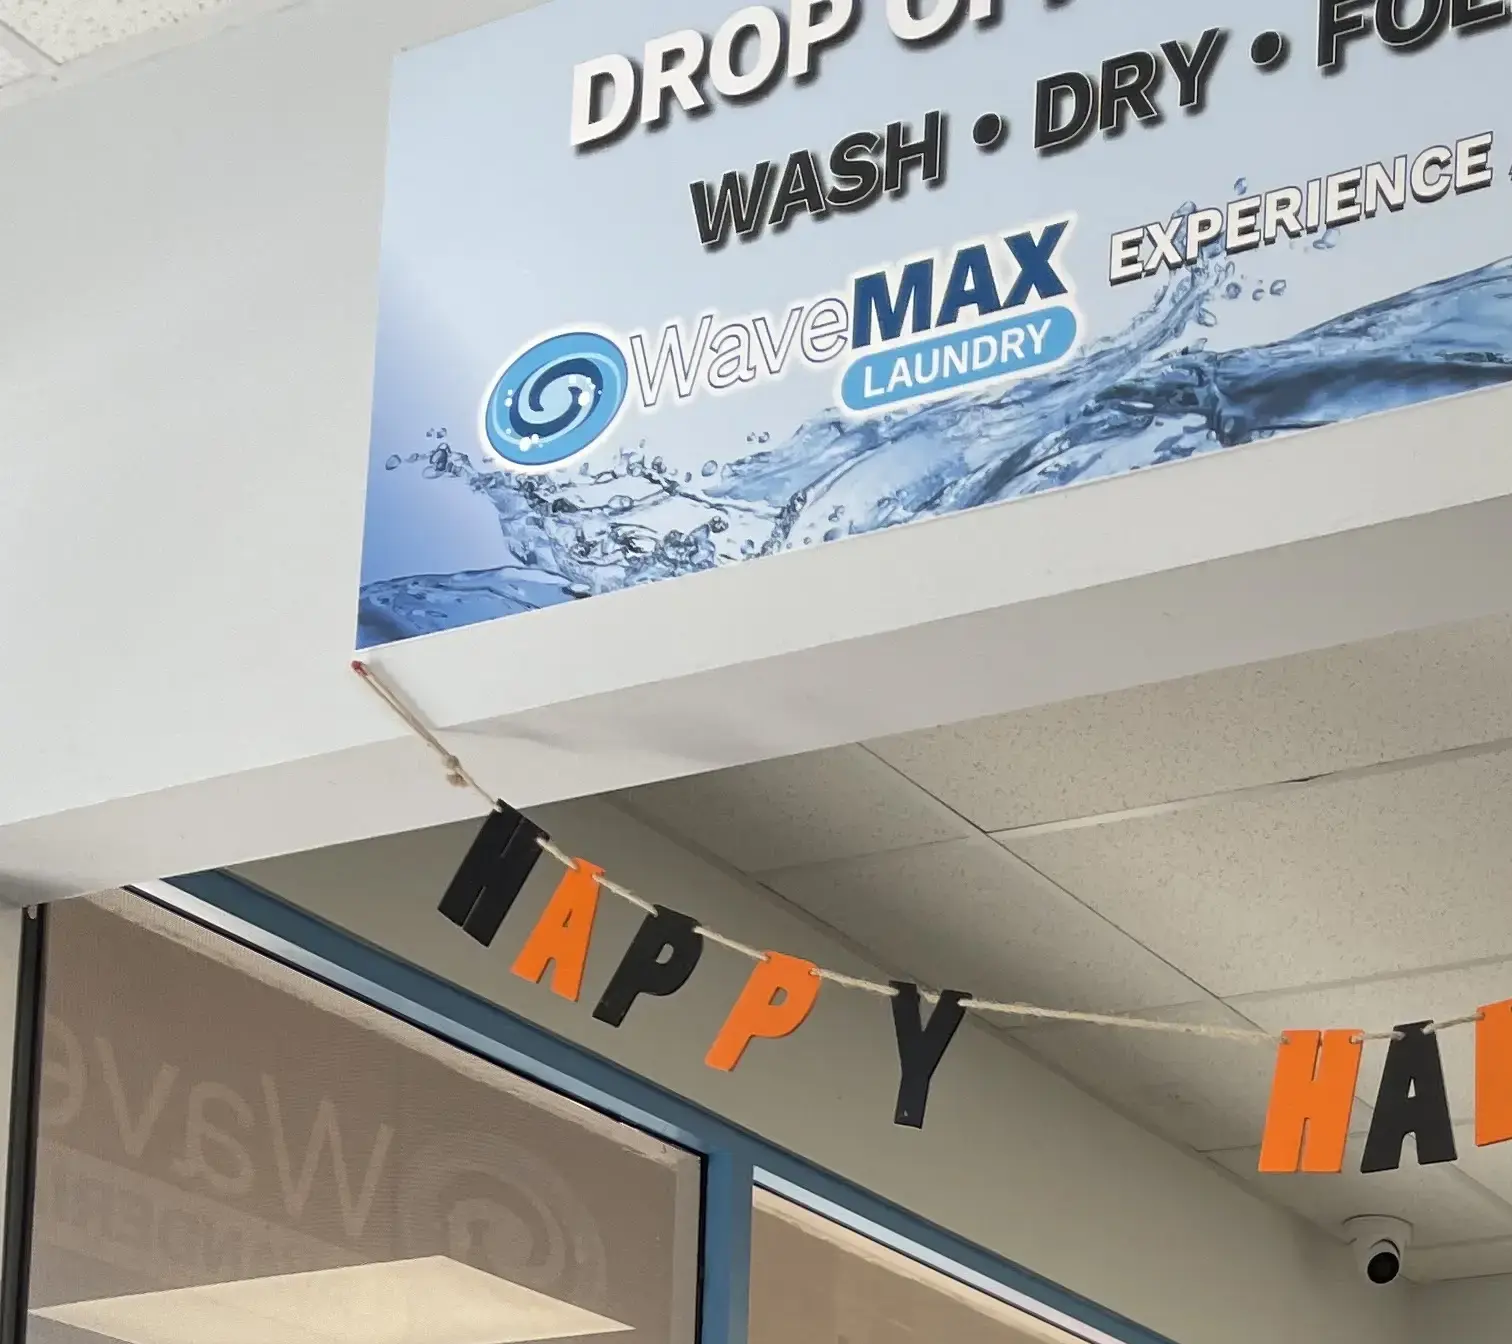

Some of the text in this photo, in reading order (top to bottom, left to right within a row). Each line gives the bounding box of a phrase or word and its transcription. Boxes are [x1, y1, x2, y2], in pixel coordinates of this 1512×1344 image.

[571, 0, 853, 147] DROP
[689, 110, 943, 245] WASH
[1033, 27, 1221, 150] DRY
[1109, 132, 1494, 285] EXPERIENCE
[862, 318, 1053, 398] LAUNDRY
[437, 798, 972, 1129] HAPPY
